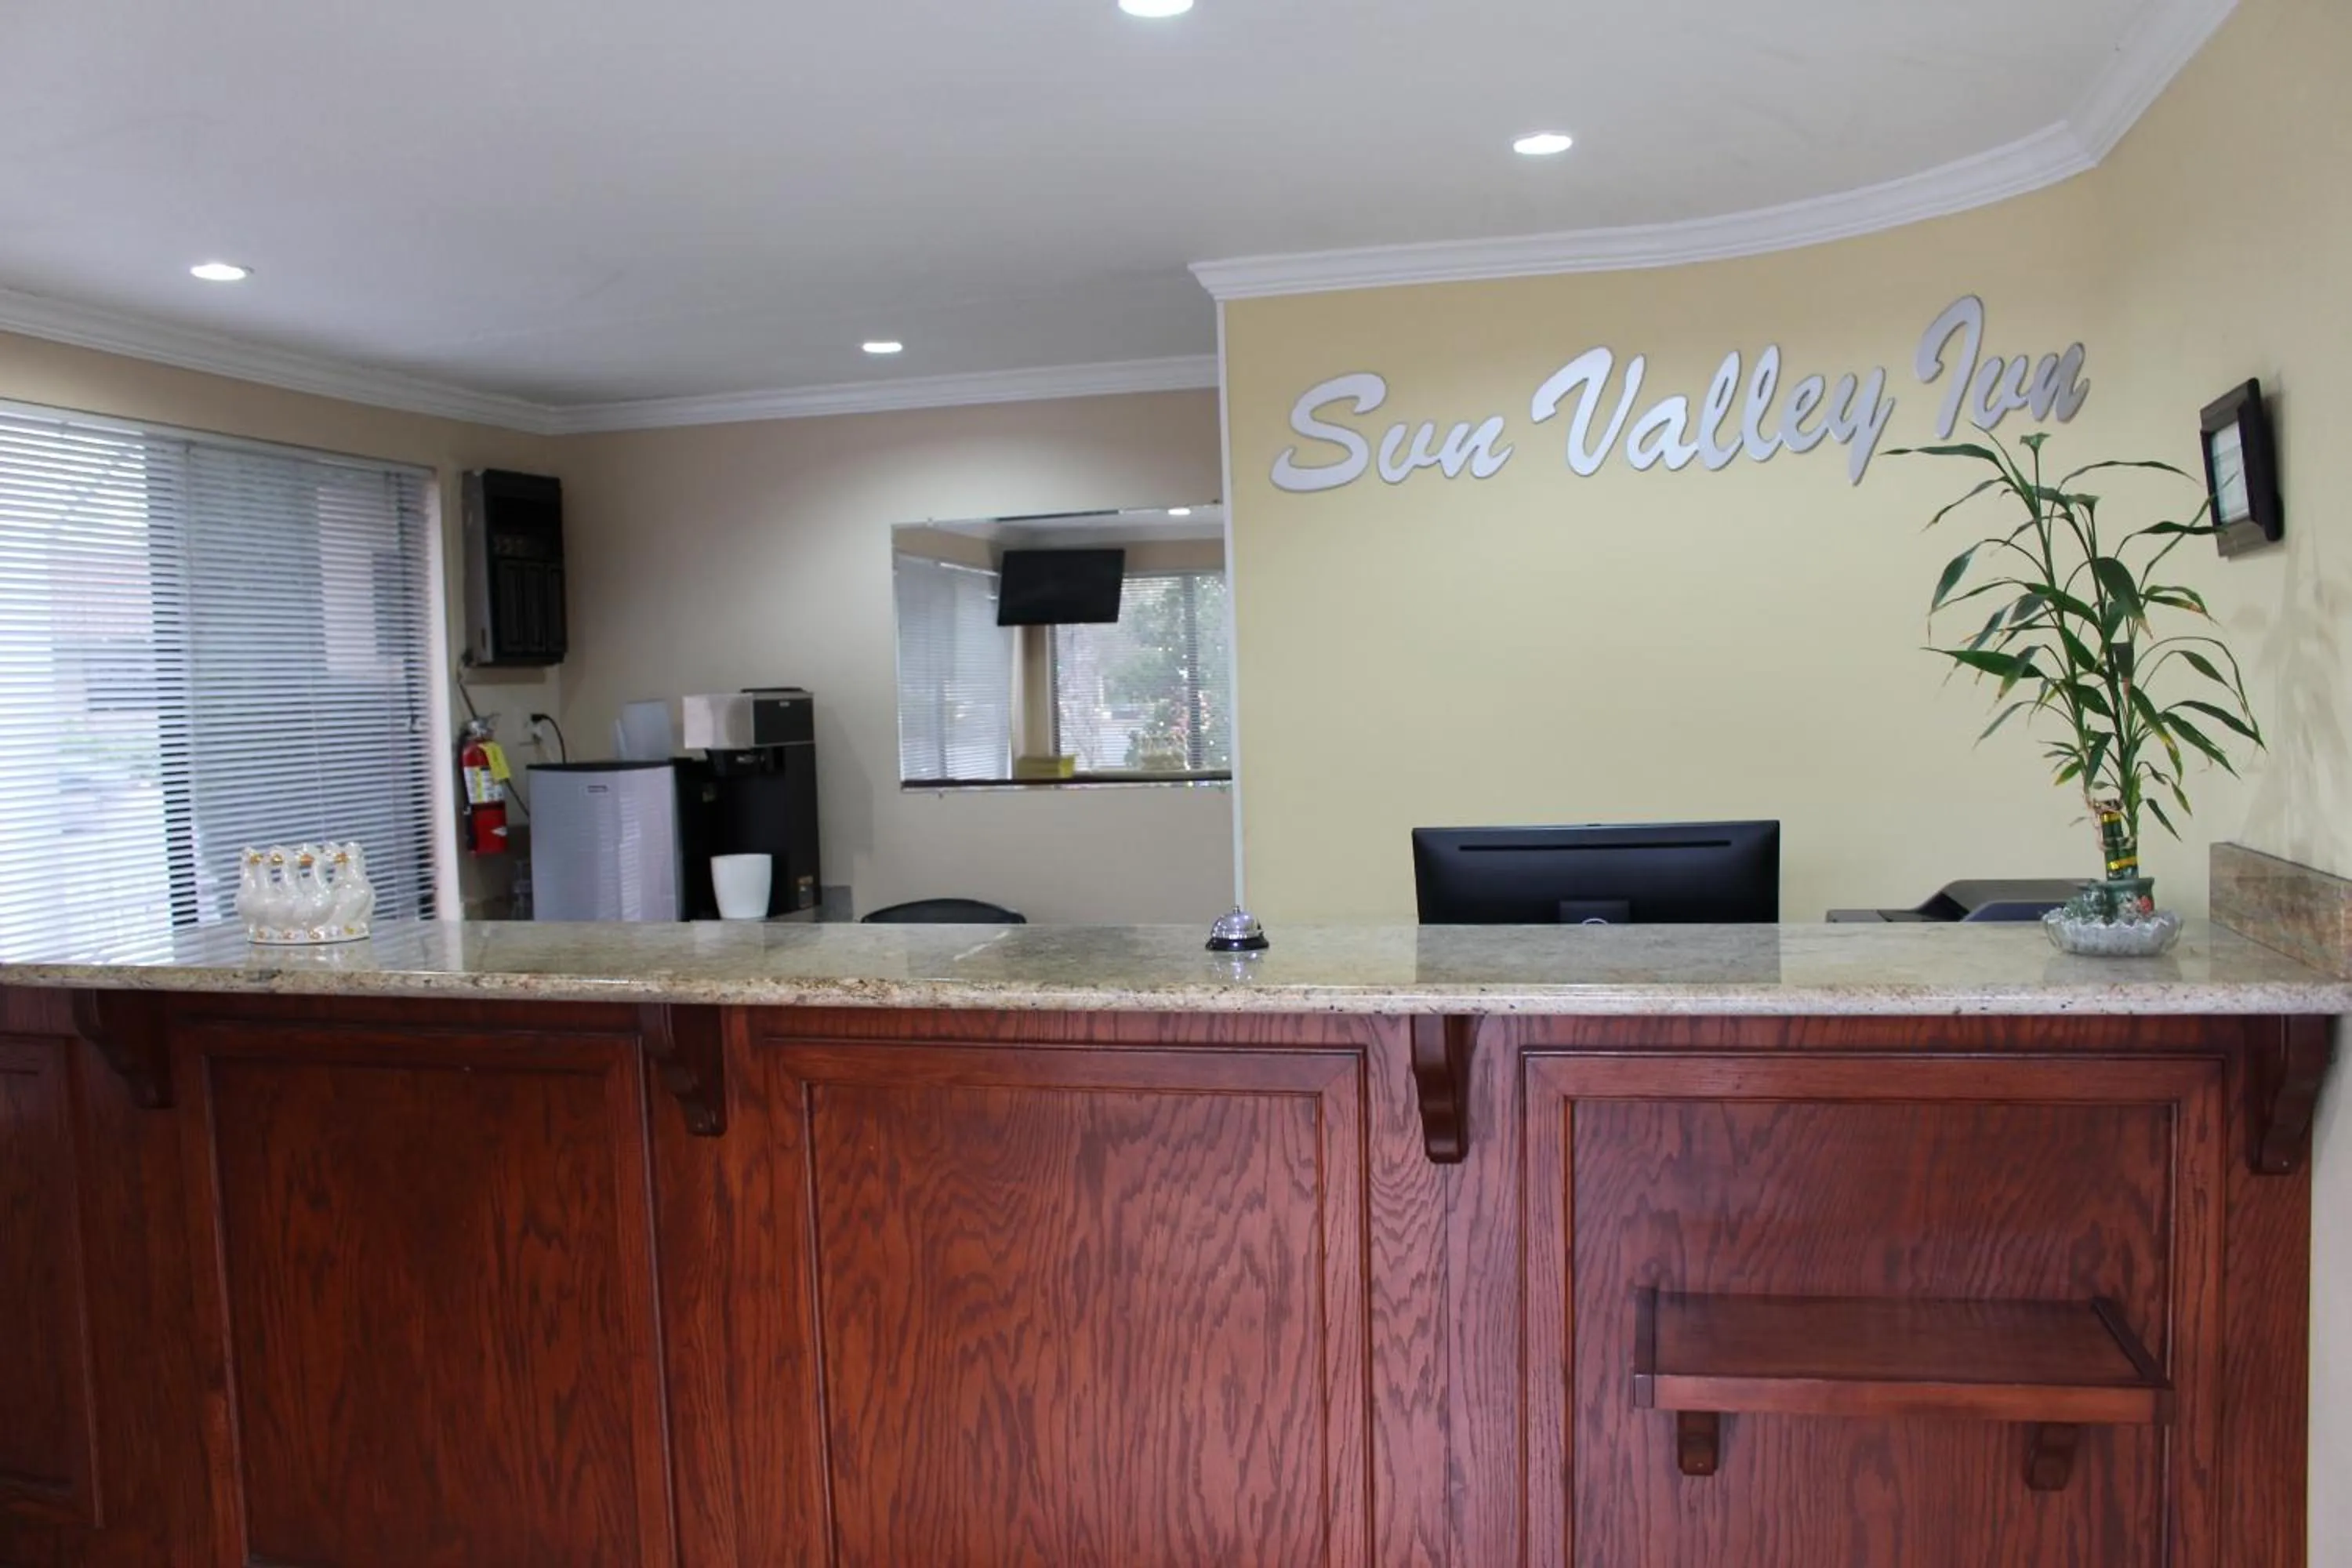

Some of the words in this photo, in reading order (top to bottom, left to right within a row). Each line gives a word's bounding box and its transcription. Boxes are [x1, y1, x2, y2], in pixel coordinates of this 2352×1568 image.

[1269, 371, 1515, 493] Sun
[1530, 343, 1896, 486] Valley
[1915, 294, 2090, 441] Inn
